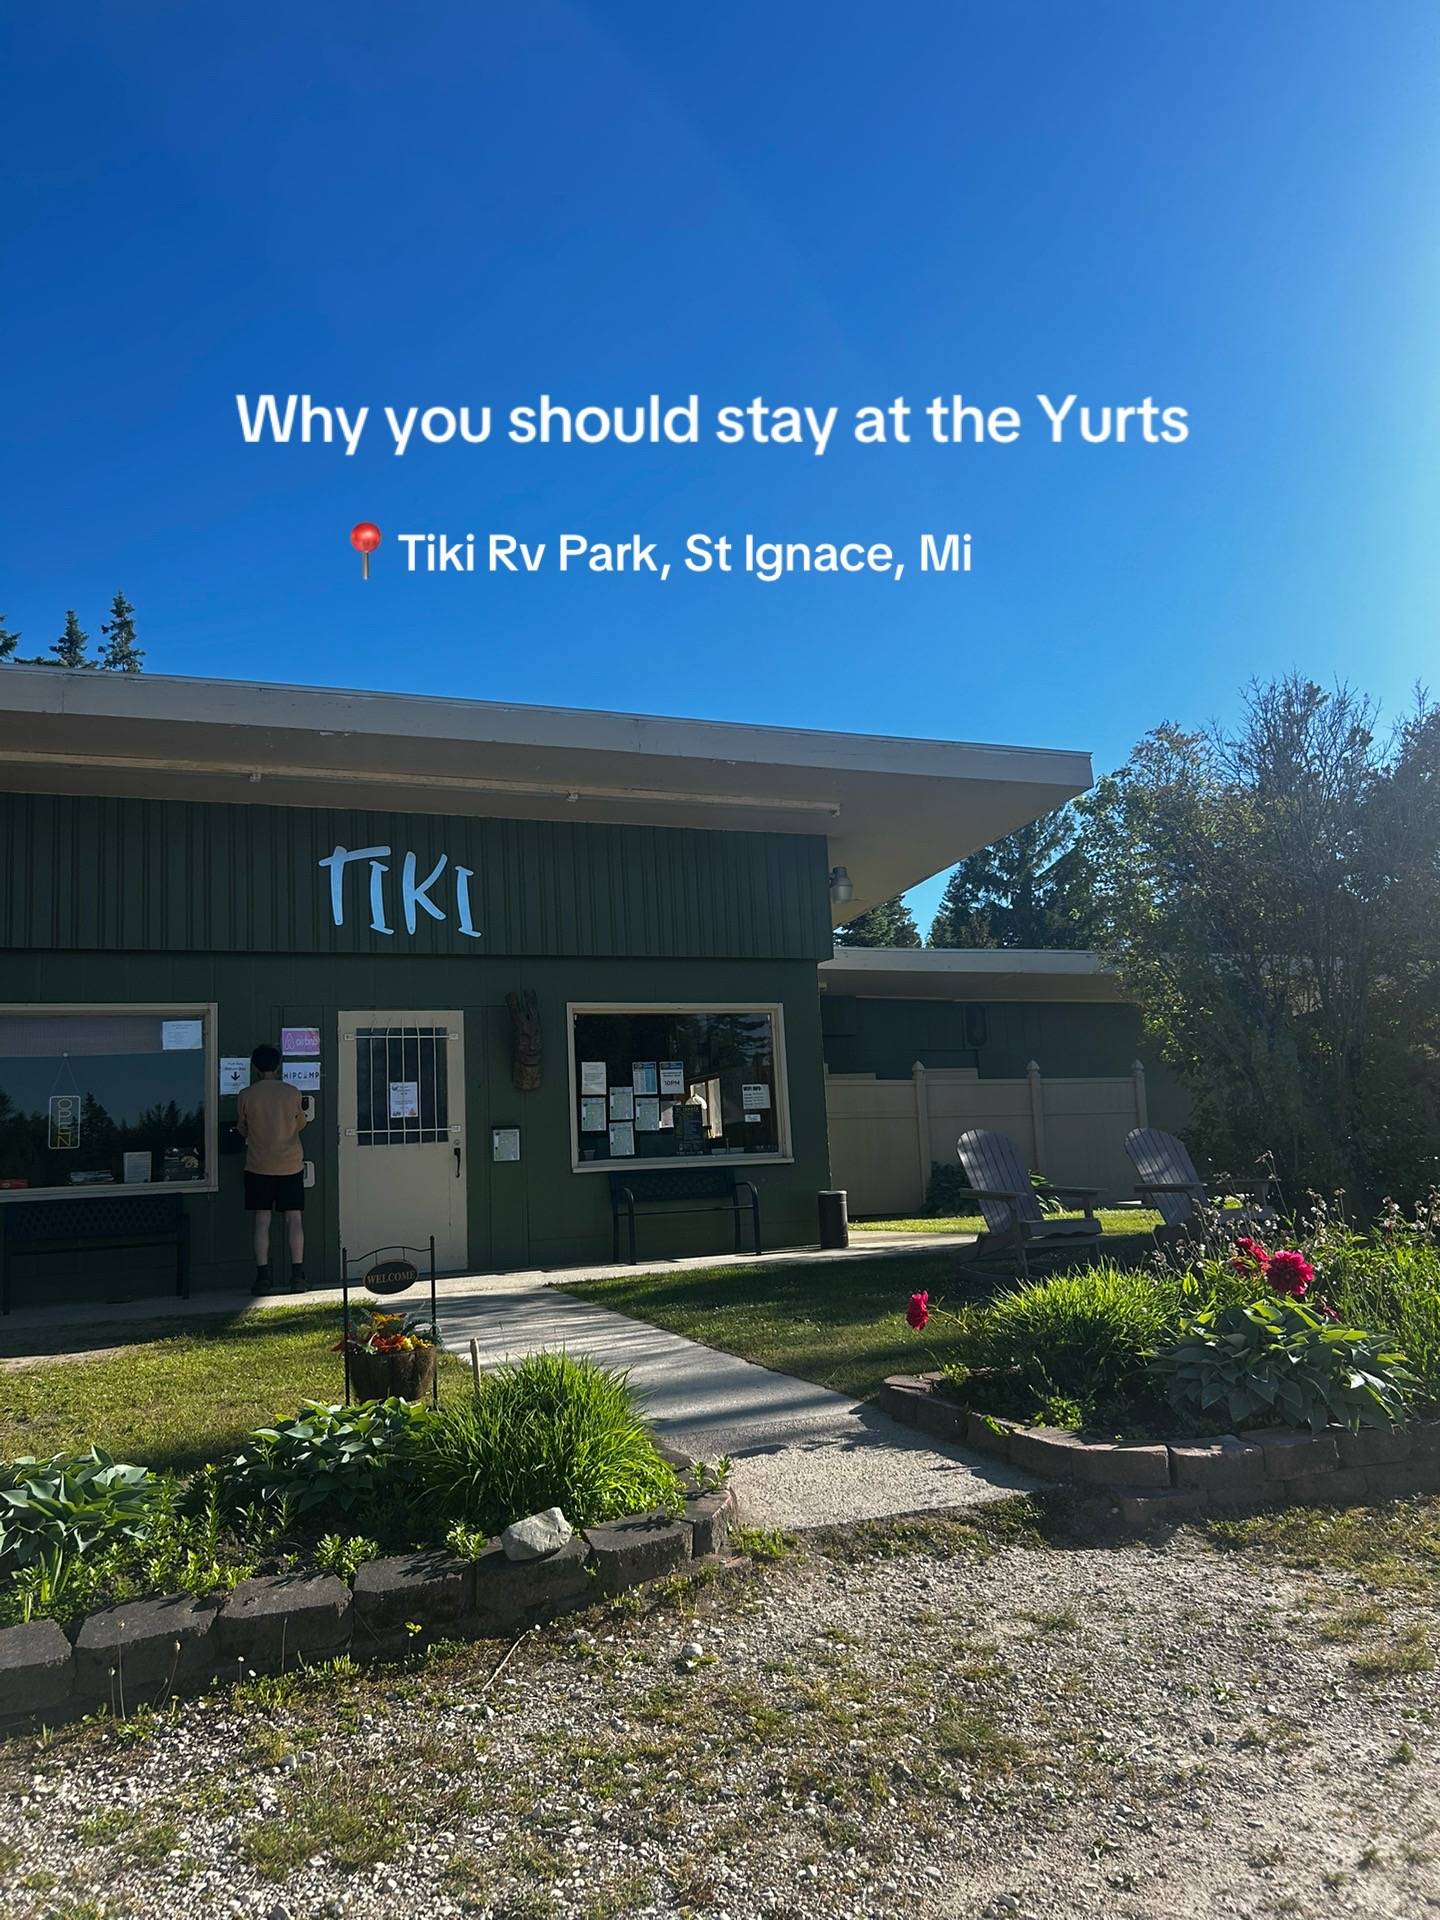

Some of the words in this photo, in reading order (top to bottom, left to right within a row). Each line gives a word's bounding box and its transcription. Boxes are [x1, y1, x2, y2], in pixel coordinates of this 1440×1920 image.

[318, 845, 483, 938] TIKI
[57, 1098, 73, 1148] OPEN
[365, 1270, 416, 1286] WELCOME
